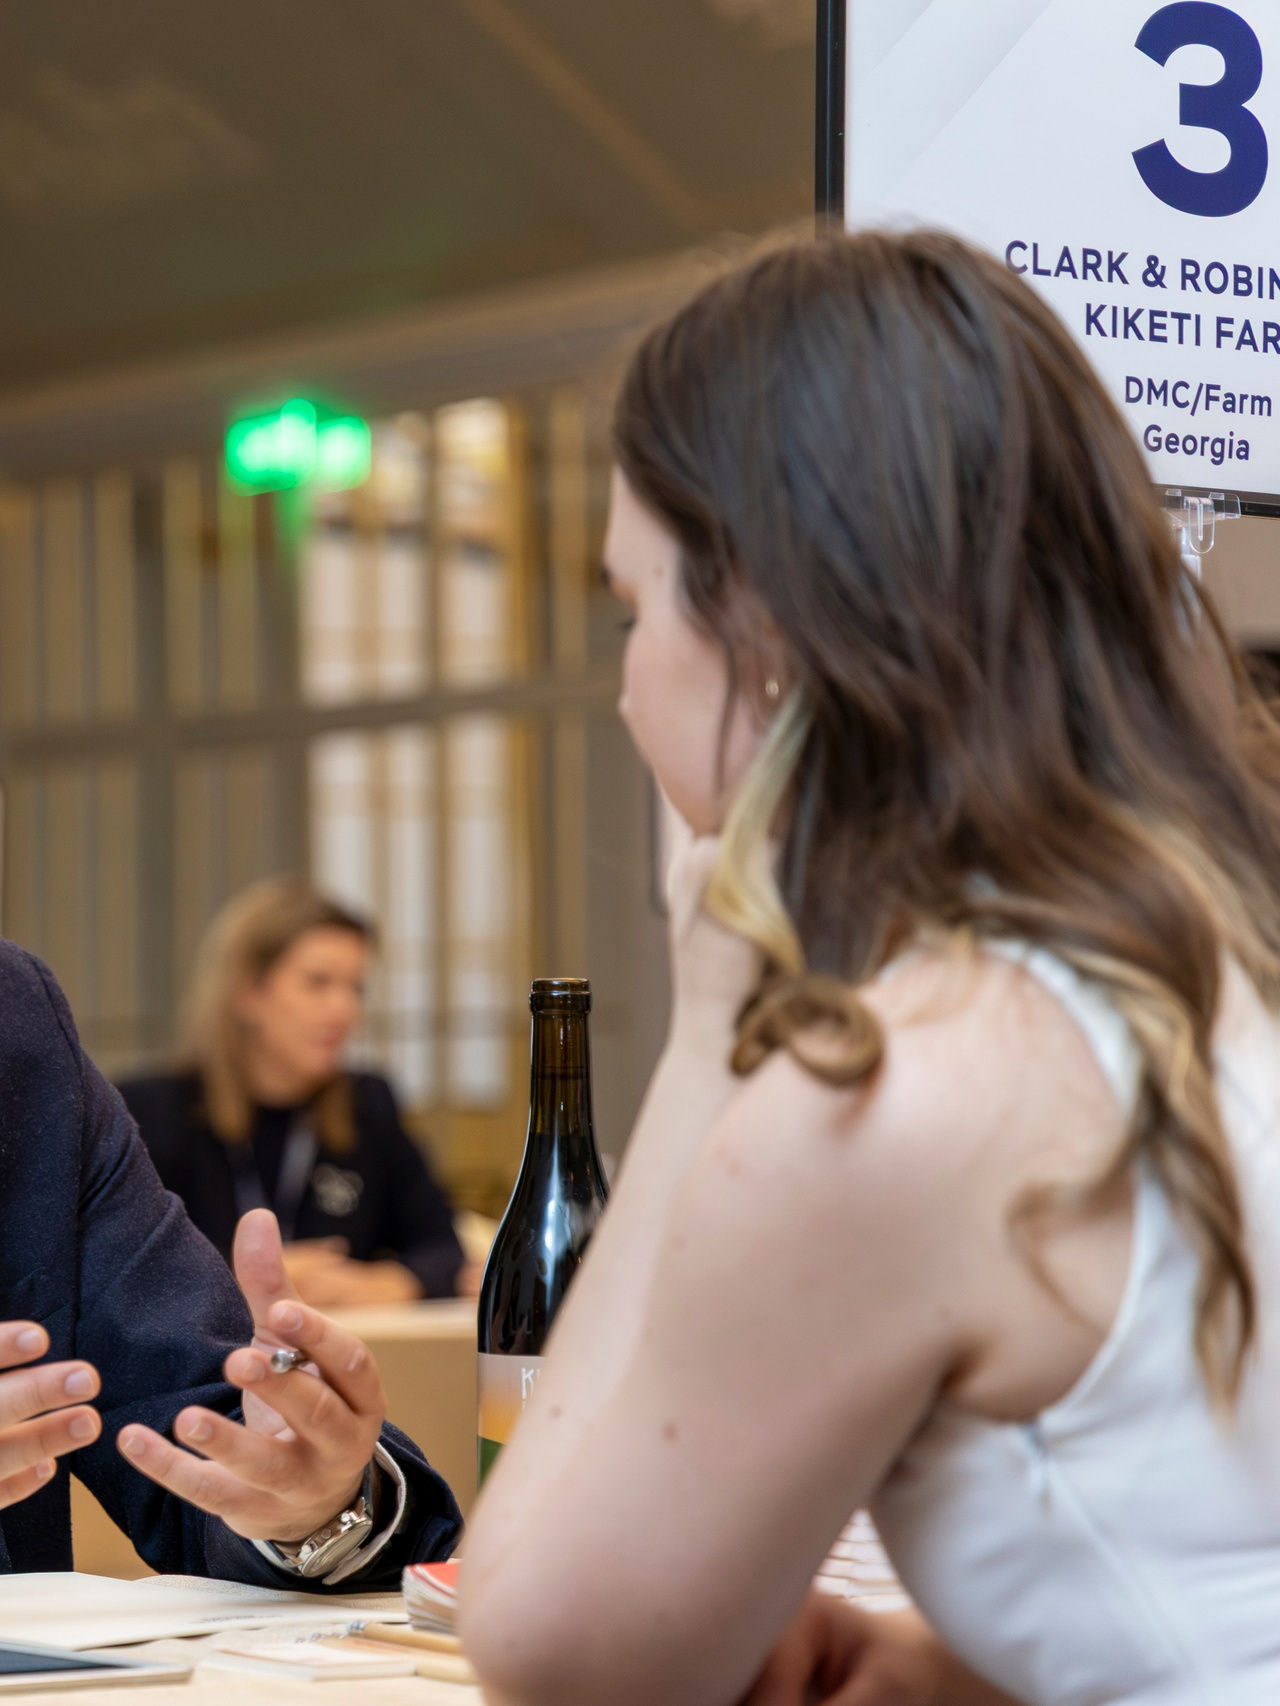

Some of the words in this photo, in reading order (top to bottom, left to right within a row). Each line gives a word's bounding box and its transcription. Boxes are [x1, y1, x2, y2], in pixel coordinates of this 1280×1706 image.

[1132, 1, 1269, 217] 3
[1005, 240, 1130, 285] CLARK
[1141, 254, 1168, 289] &
[1085, 302, 1201, 347] KIKETI
[1215, 316, 1280, 355] FAR
[1124, 375, 1273, 417] DMC/Farm
[1143, 424, 1251, 466] Georgia
